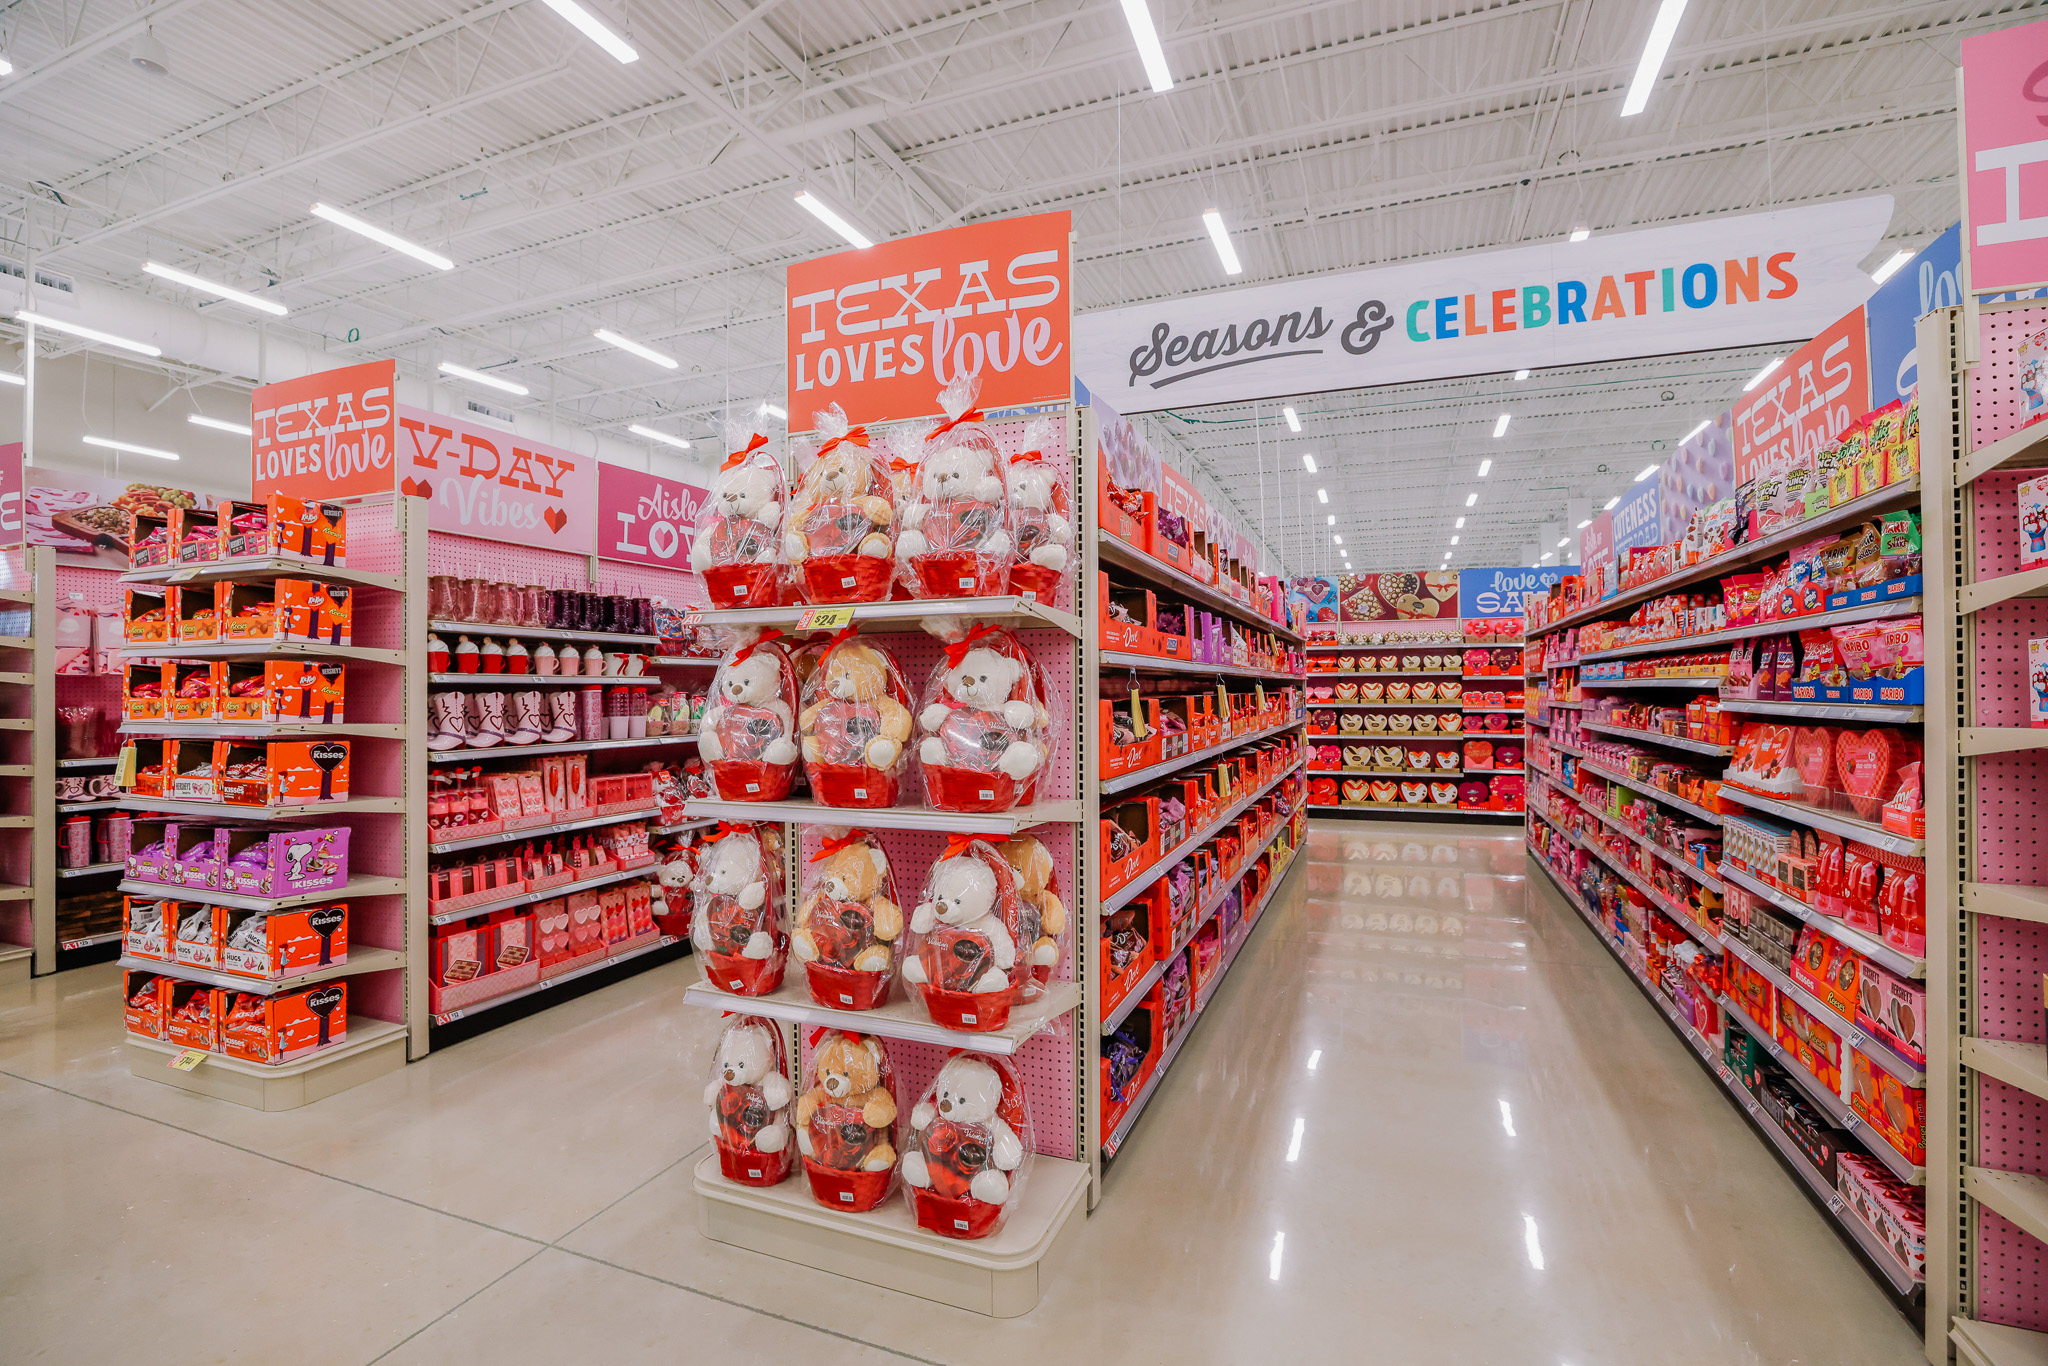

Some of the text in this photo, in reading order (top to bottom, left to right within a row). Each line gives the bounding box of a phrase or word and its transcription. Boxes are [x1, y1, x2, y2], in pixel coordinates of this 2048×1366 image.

[793, 249, 1061, 345] TEXAS
[1129, 251, 1800, 386] Seasons & CELEBRATIONS
[796, 309, 1064, 392] LOVES love
[1736, 335, 1853, 456] TEXAS
[253, 386, 392, 448] TEXAS
[255, 428, 393, 482] LOVES love
[400, 417, 576, 499] V-DAY
[439, 473, 541, 530] Vibes
[637, 482, 698, 523] Aisle
[1164, 475, 1206, 530] TEXAS
[1613, 487, 1658, 542] CUTENESS
[1490, 571, 1540, 593] love
[1887, 583, 1906, 595] HARIBO
[1861, 590, 1877, 602] HARIBO
[814, 614, 838, 626] $24
[1792, 685, 1816, 699] HARIBO
[1853, 687, 1874, 700] HARIBO
[1880, 687, 1905, 701] HARIBO
[64, 942, 79, 951] A1
[226, 953, 242, 963] HUGS
[1862, 964, 1880, 985] HERSHEY'S
[1827, 990, 1846, 1014] Reese's
[1890, 982, 1914, 1006] HERSHEY'S
[437, 1012, 451, 1025] A1
